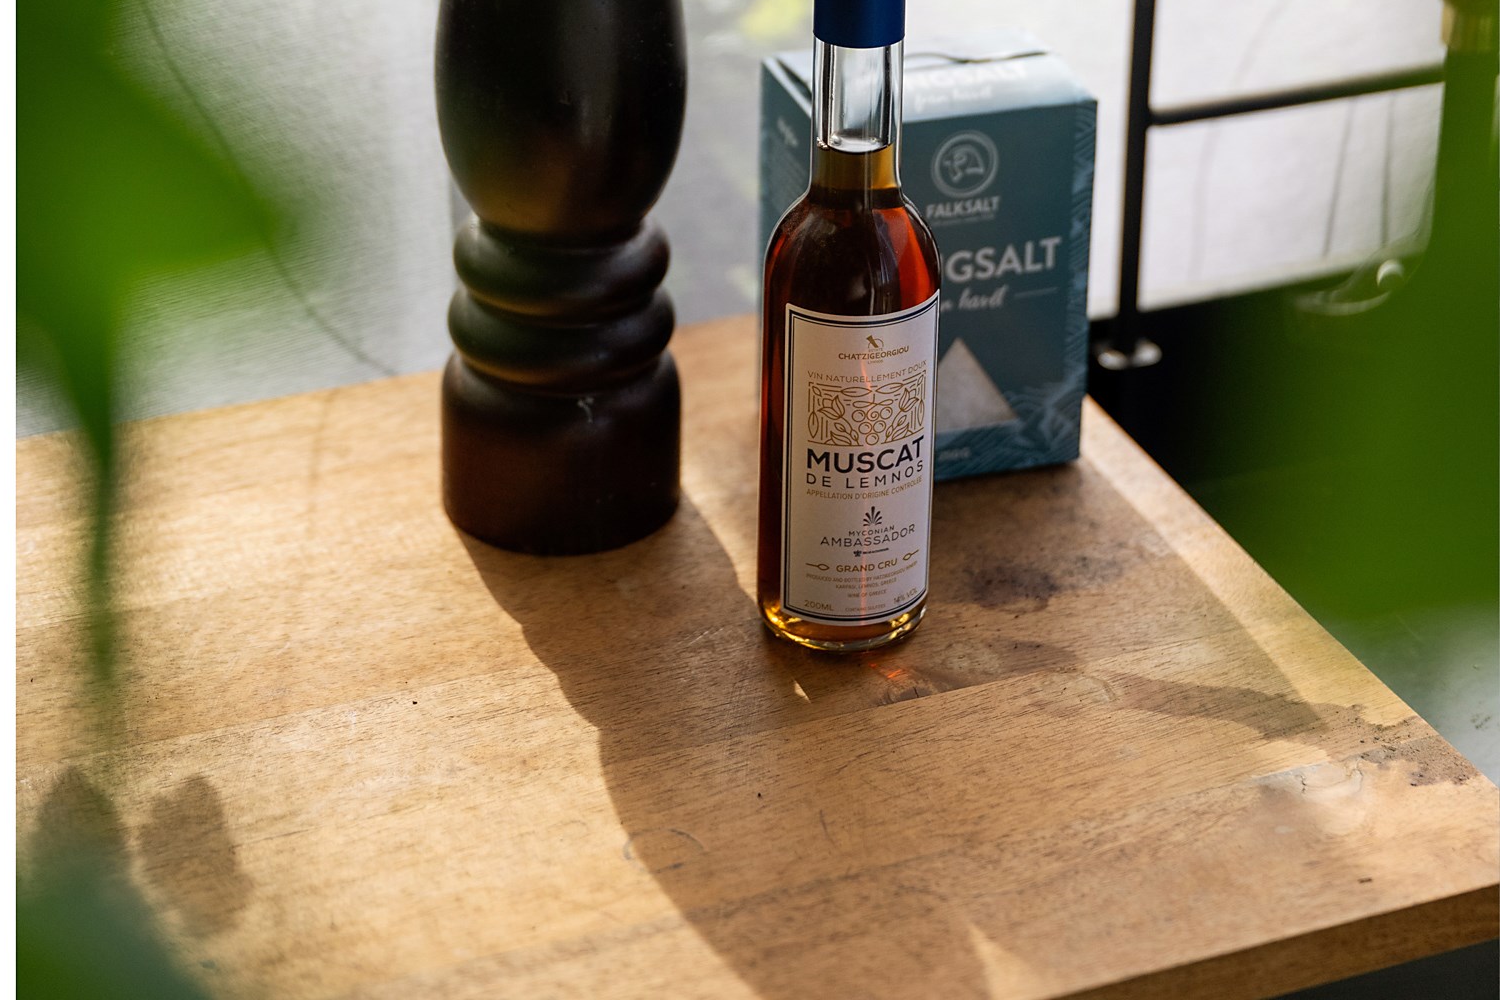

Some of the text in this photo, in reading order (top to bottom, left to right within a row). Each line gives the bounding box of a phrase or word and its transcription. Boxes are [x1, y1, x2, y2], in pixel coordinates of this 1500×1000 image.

[925, 195, 1000, 219] FALKSALT
[941, 236, 1063, 284] GSALT
[838, 345, 909, 360] CHATZIGEORGIOU
[807, 359, 927, 383] VIN NATURELLEMENT DOUX
[807, 434, 924, 474] MUSCAT
[806, 460, 923, 489] DE LEMNOS
[807, 488, 853, 500] APPELLATION
[855, 489, 890, 500] D'ORIGINE
[820, 523, 916, 548] AMBASSADOR
[848, 525, 895, 537] MYCONIAN
[836, 558, 898, 573] GRAND CRU
[804, 599, 834, 612] 200ML
